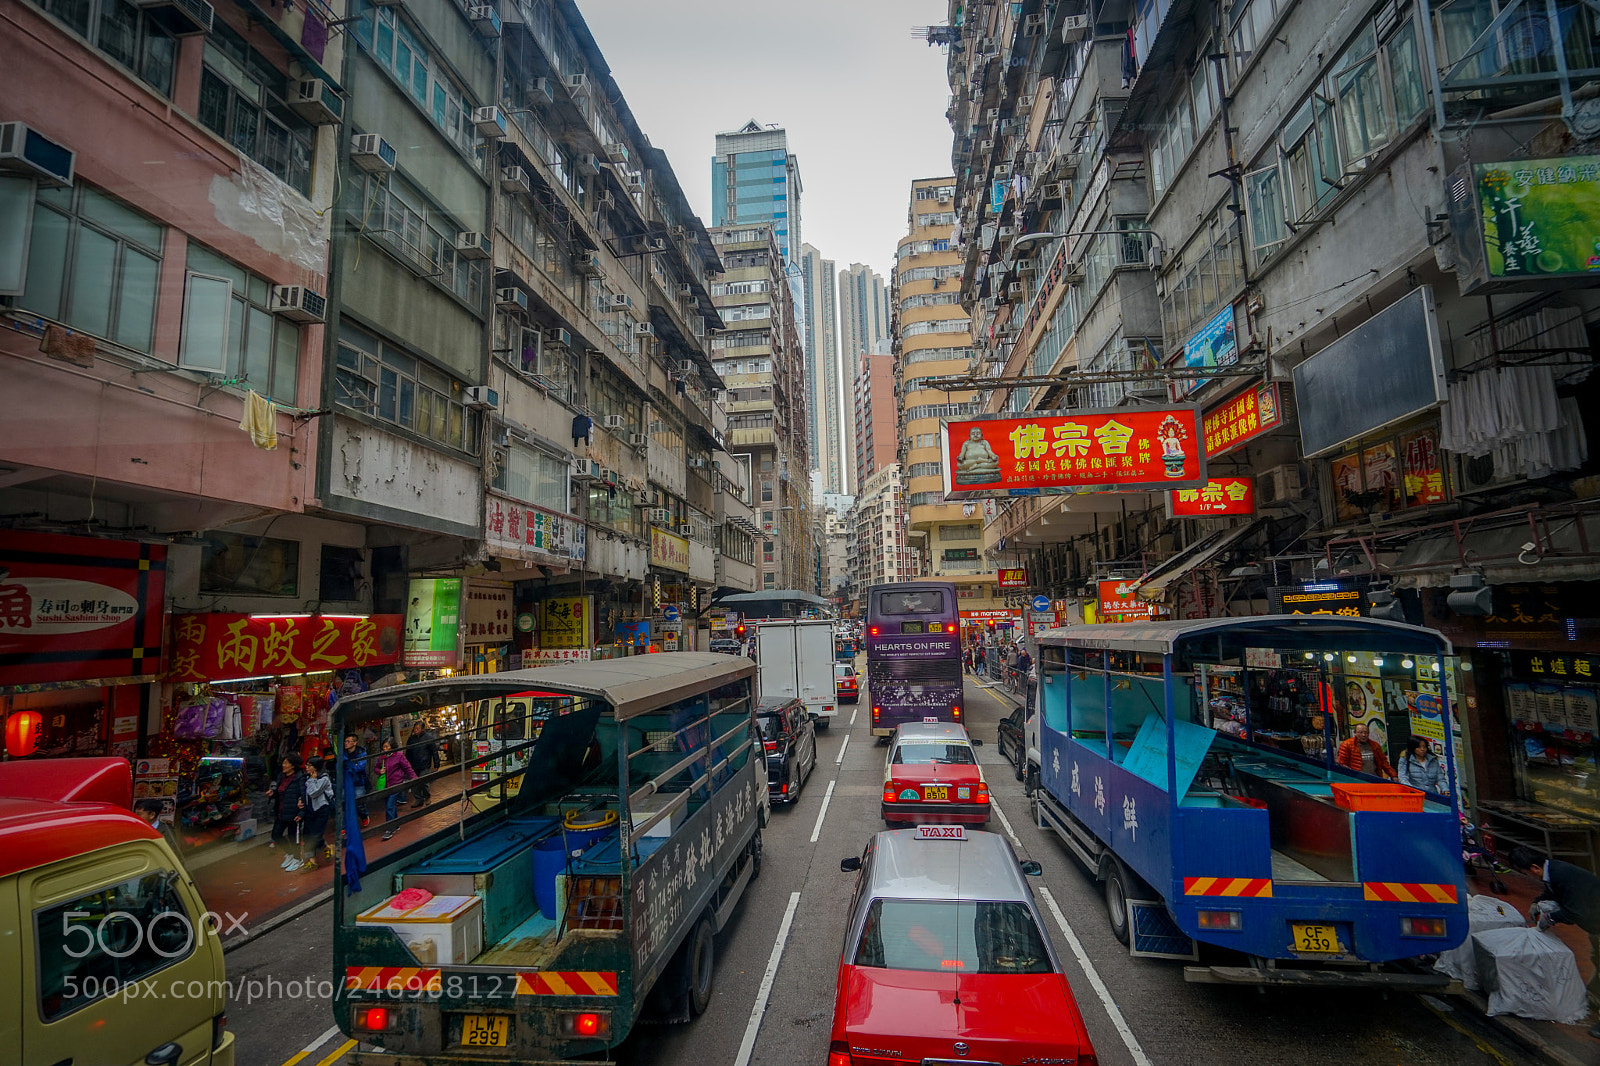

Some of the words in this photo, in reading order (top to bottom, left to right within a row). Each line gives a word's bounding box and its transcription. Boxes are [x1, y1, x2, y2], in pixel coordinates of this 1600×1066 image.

[1008, 419, 1134, 460] 佛宗舍
[1199, 503, 1212, 511] 1/F
[100, 614, 121, 623] Shop
[874, 643, 913, 651] HEARTS
[913, 642, 928, 650] ON
[929, 642, 951, 650] FIRE
[920, 827, 963, 838] TAXI
[1304, 926, 1323, 939] CF
[1302, 938, 1330, 951] 239
[475, 1016, 496, 1031] LW
[469, 1031, 499, 1045] 299
